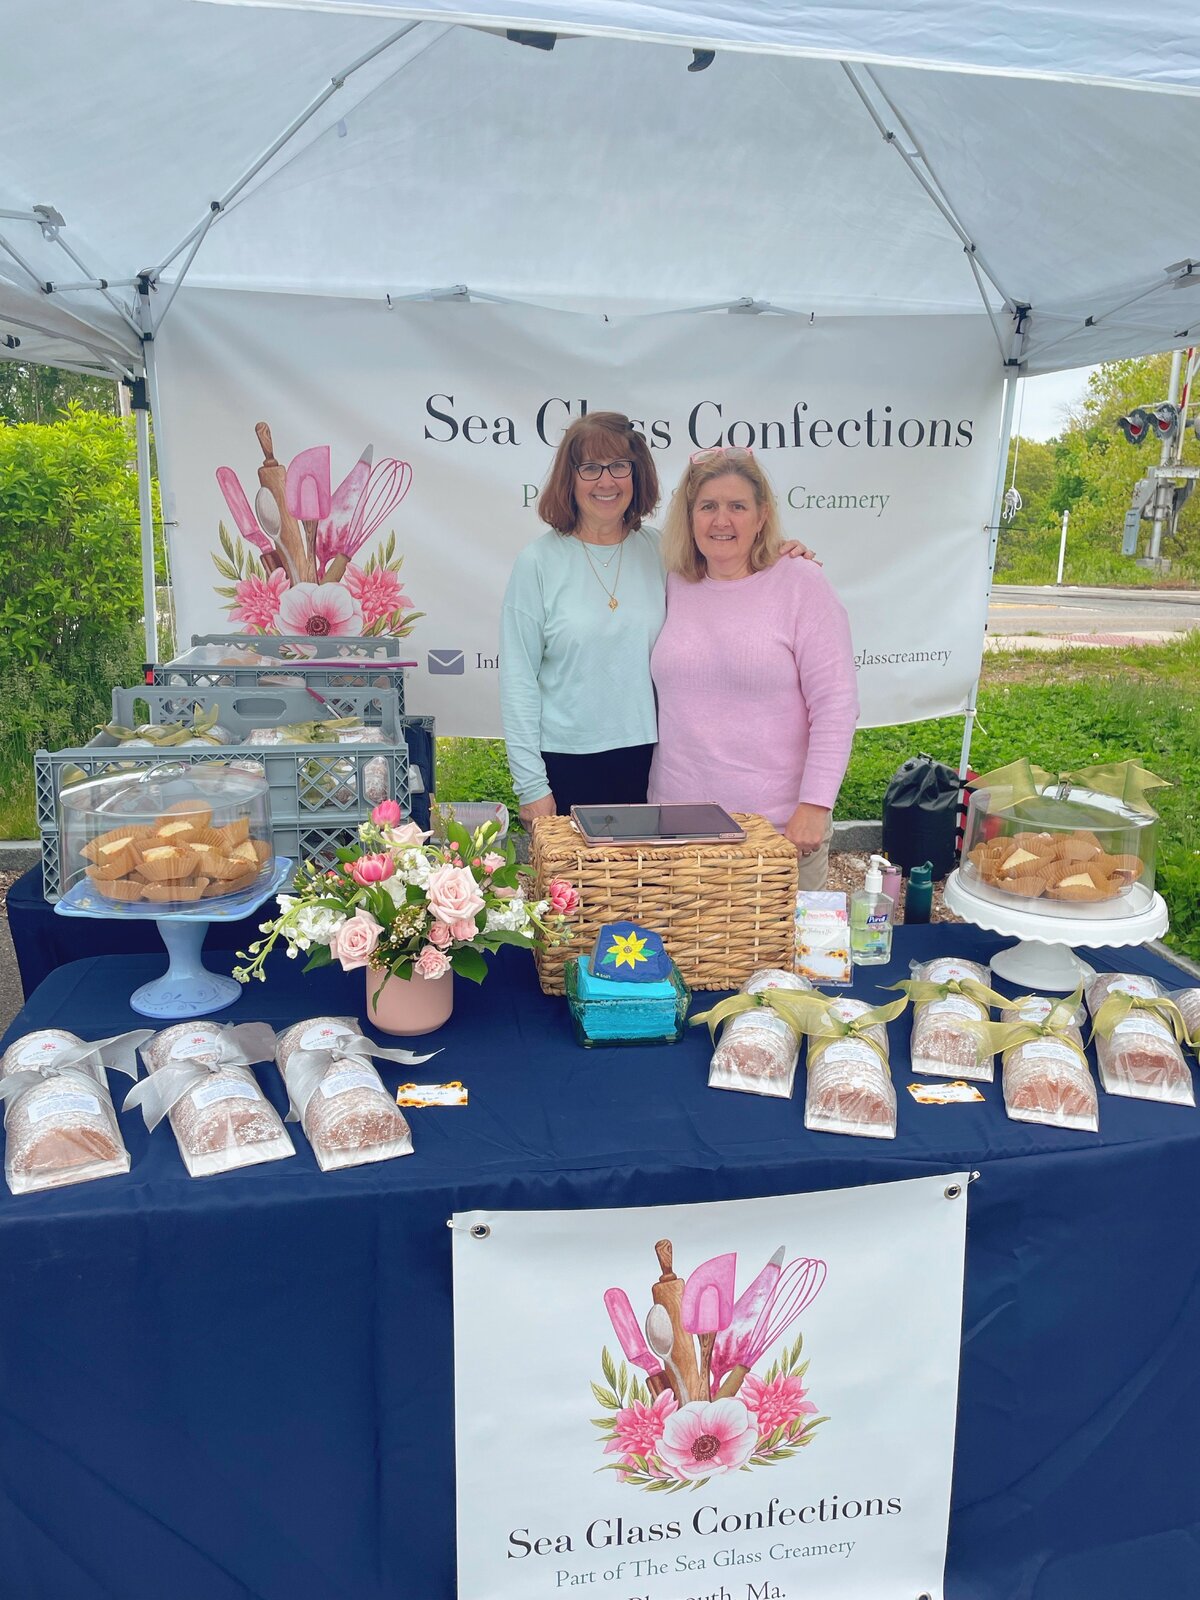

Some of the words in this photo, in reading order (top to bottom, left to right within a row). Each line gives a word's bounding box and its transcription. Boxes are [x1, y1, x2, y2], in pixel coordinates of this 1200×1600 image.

[424, 394, 522, 446] Sea
[688, 400, 974, 450] Confections
[787, 486, 890, 518] Creamery
[507, 1529, 575, 1559] Sea
[586, 1517, 682, 1549] Glass
[692, 1495, 902, 1536] Confections
[555, 1569, 597, 1587] Part
[603, 1562, 626, 1581] of
[629, 1559, 669, 1578] The
[674, 1554, 706, 1572] Sea
[713, 1548, 762, 1567] Glass
[769, 1541, 856, 1560] Creamery
[745, 1581, 786, 1600] Ma.
